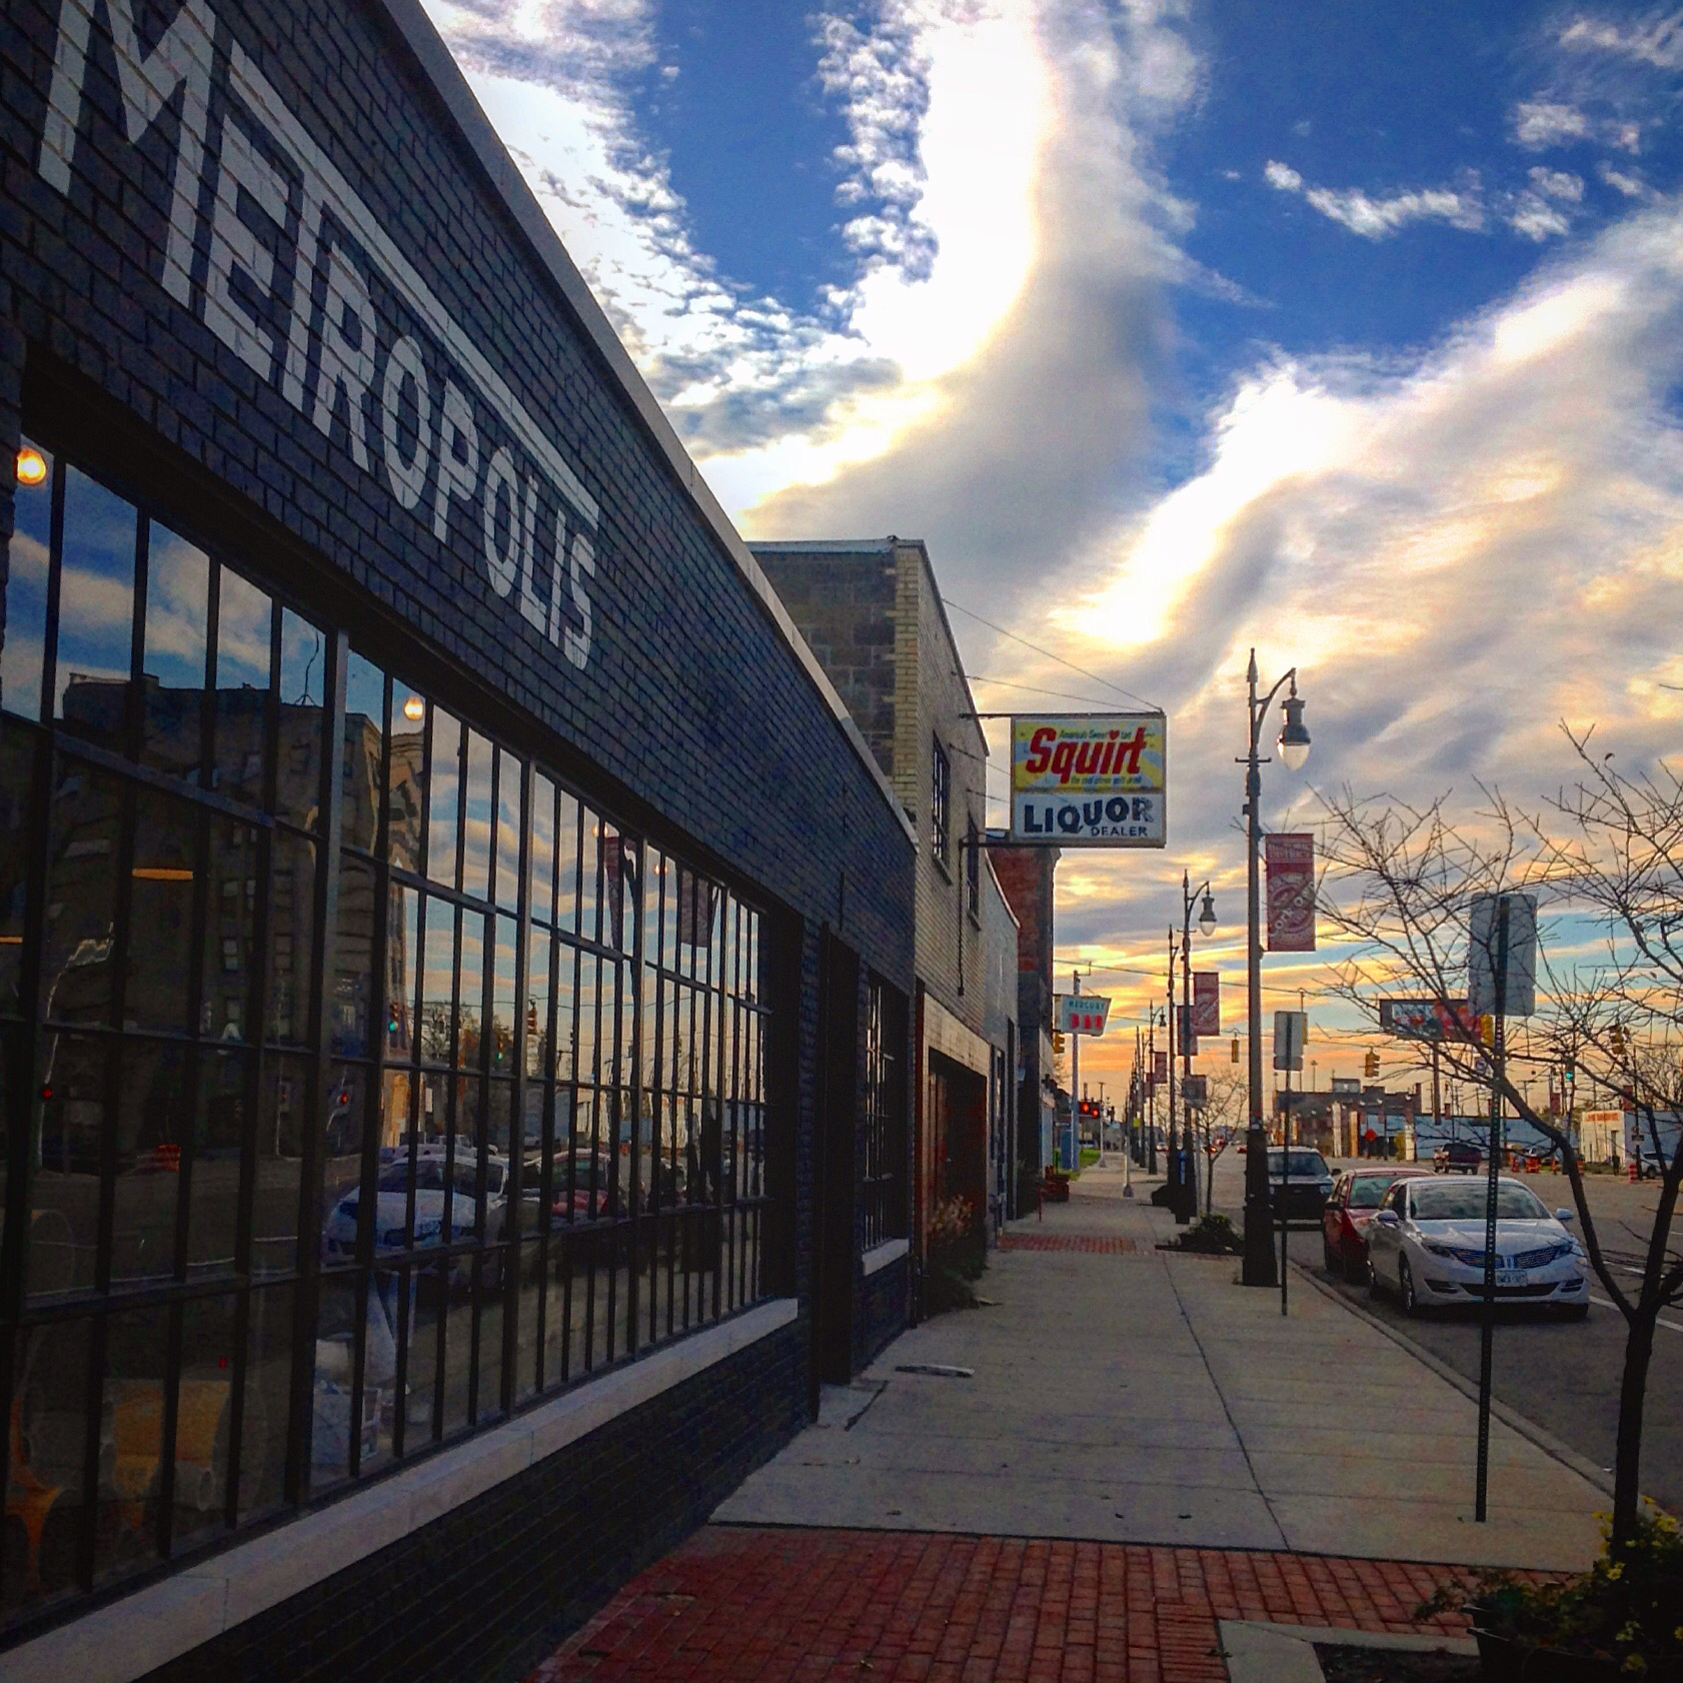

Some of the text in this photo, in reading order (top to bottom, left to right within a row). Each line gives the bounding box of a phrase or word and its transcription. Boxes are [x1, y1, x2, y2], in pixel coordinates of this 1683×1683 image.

[38, 0, 601, 670] METROPOLIS
[1025, 726, 1147, 784] Squirt
[1024, 797, 1153, 834] LIQUOR
[1091, 826, 1148, 837] DEALER
[1268, 880, 1314, 937] Corkown
[1070, 1012, 1103, 1029] BAR
